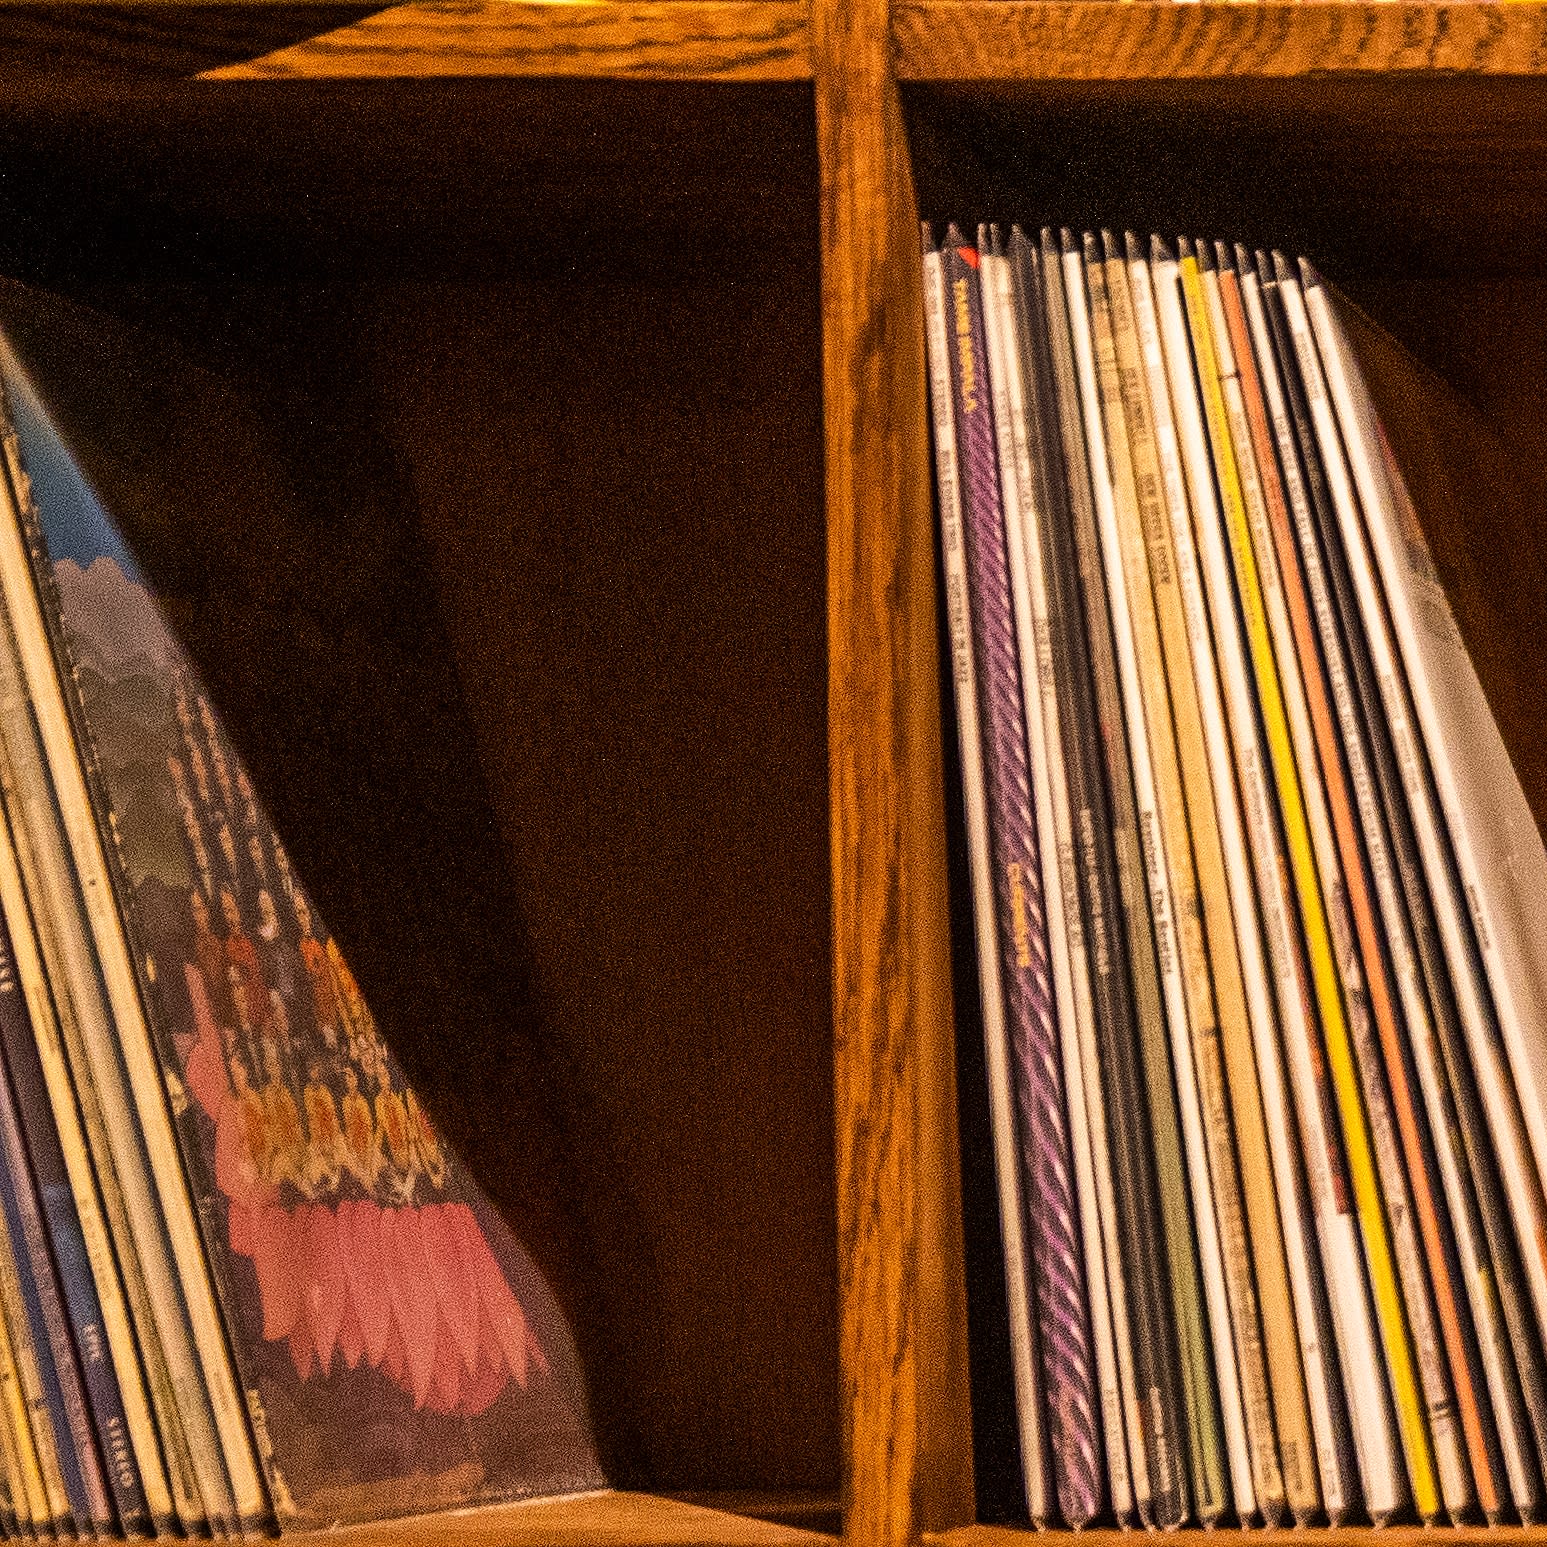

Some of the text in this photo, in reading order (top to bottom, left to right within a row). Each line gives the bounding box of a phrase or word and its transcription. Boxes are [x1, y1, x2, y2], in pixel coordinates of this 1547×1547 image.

[1141, 809, 1175, 975] Revolver The Beatles
[105, 1415, 134, 1490] STEREO
